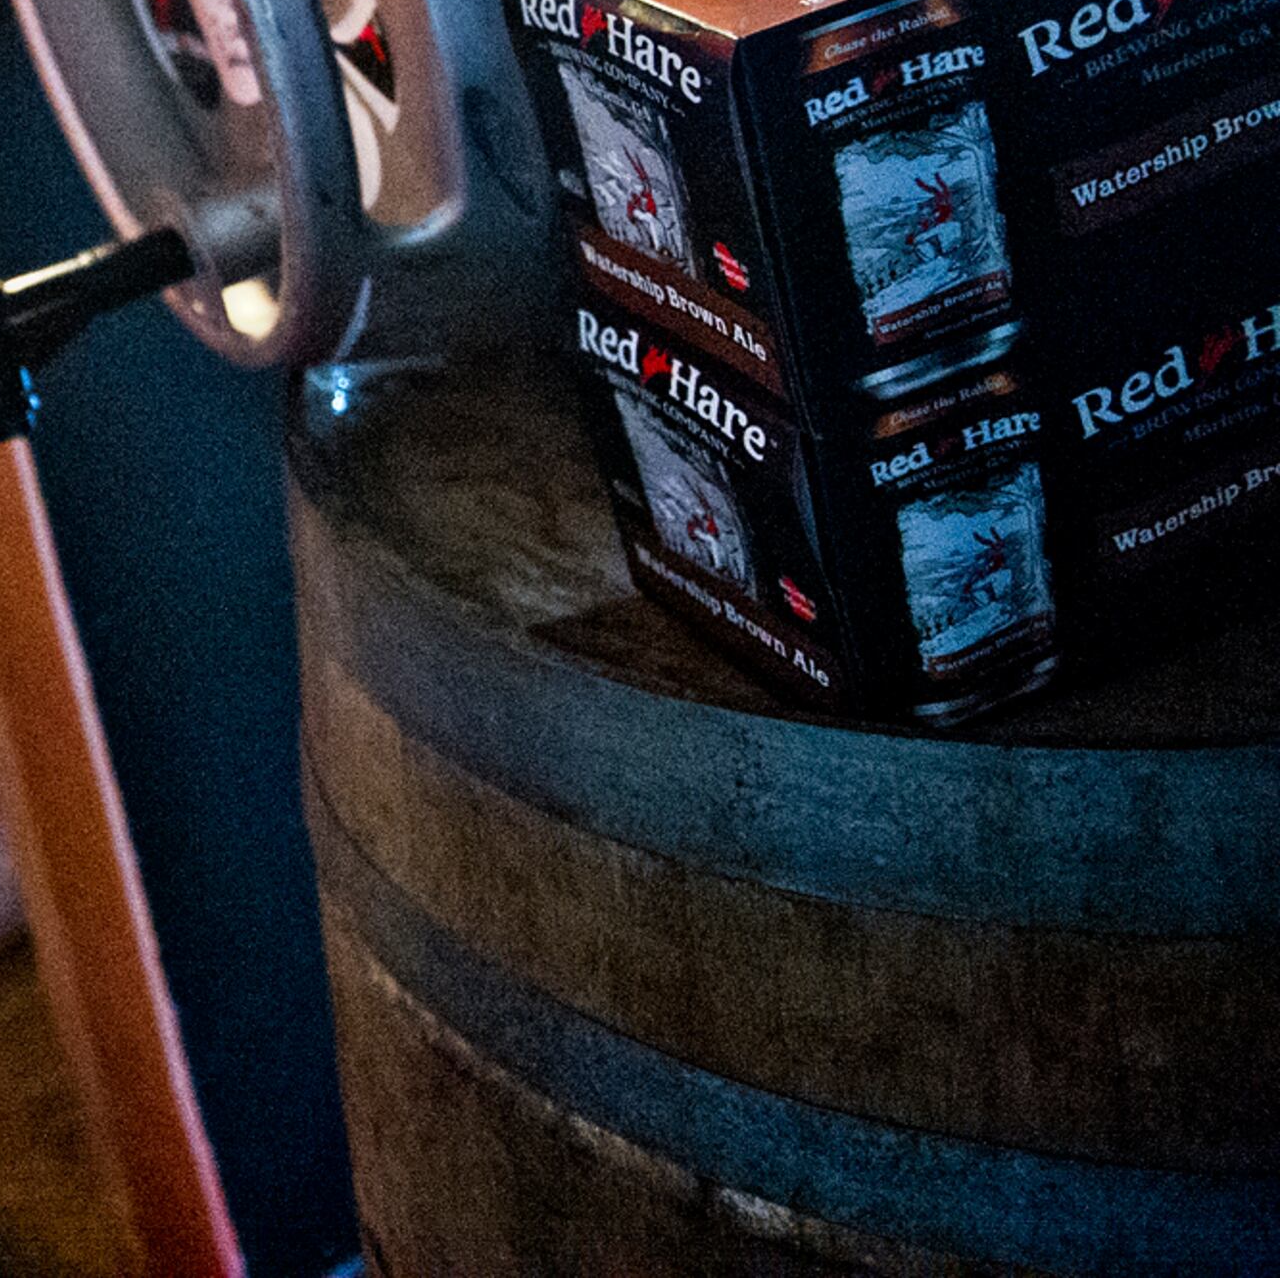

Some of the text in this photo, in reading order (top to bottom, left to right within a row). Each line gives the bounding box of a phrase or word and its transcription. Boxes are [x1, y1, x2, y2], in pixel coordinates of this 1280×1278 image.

[605, 12, 704, 105] Hare
[869, 26, 896, 44] the
[1084, 19, 1192, 78] BREWING
[803, 44, 988, 129] Red Hare
[1070, 132, 1210, 209] Watership
[579, 240, 666, 307] Watership
[665, 284, 730, 339] Brown
[733, 322, 768, 363] Ale
[577, 307, 640, 376] Red
[668, 357, 767, 463] Hare
[1070, 343, 1195, 441] Red
[869, 440, 935, 489] Red
[961, 410, 1042, 452] Hare
[1111, 481, 1243, 554] Watership
[722, 599, 789, 659] Brown
[792, 647, 831, 689] Ale
